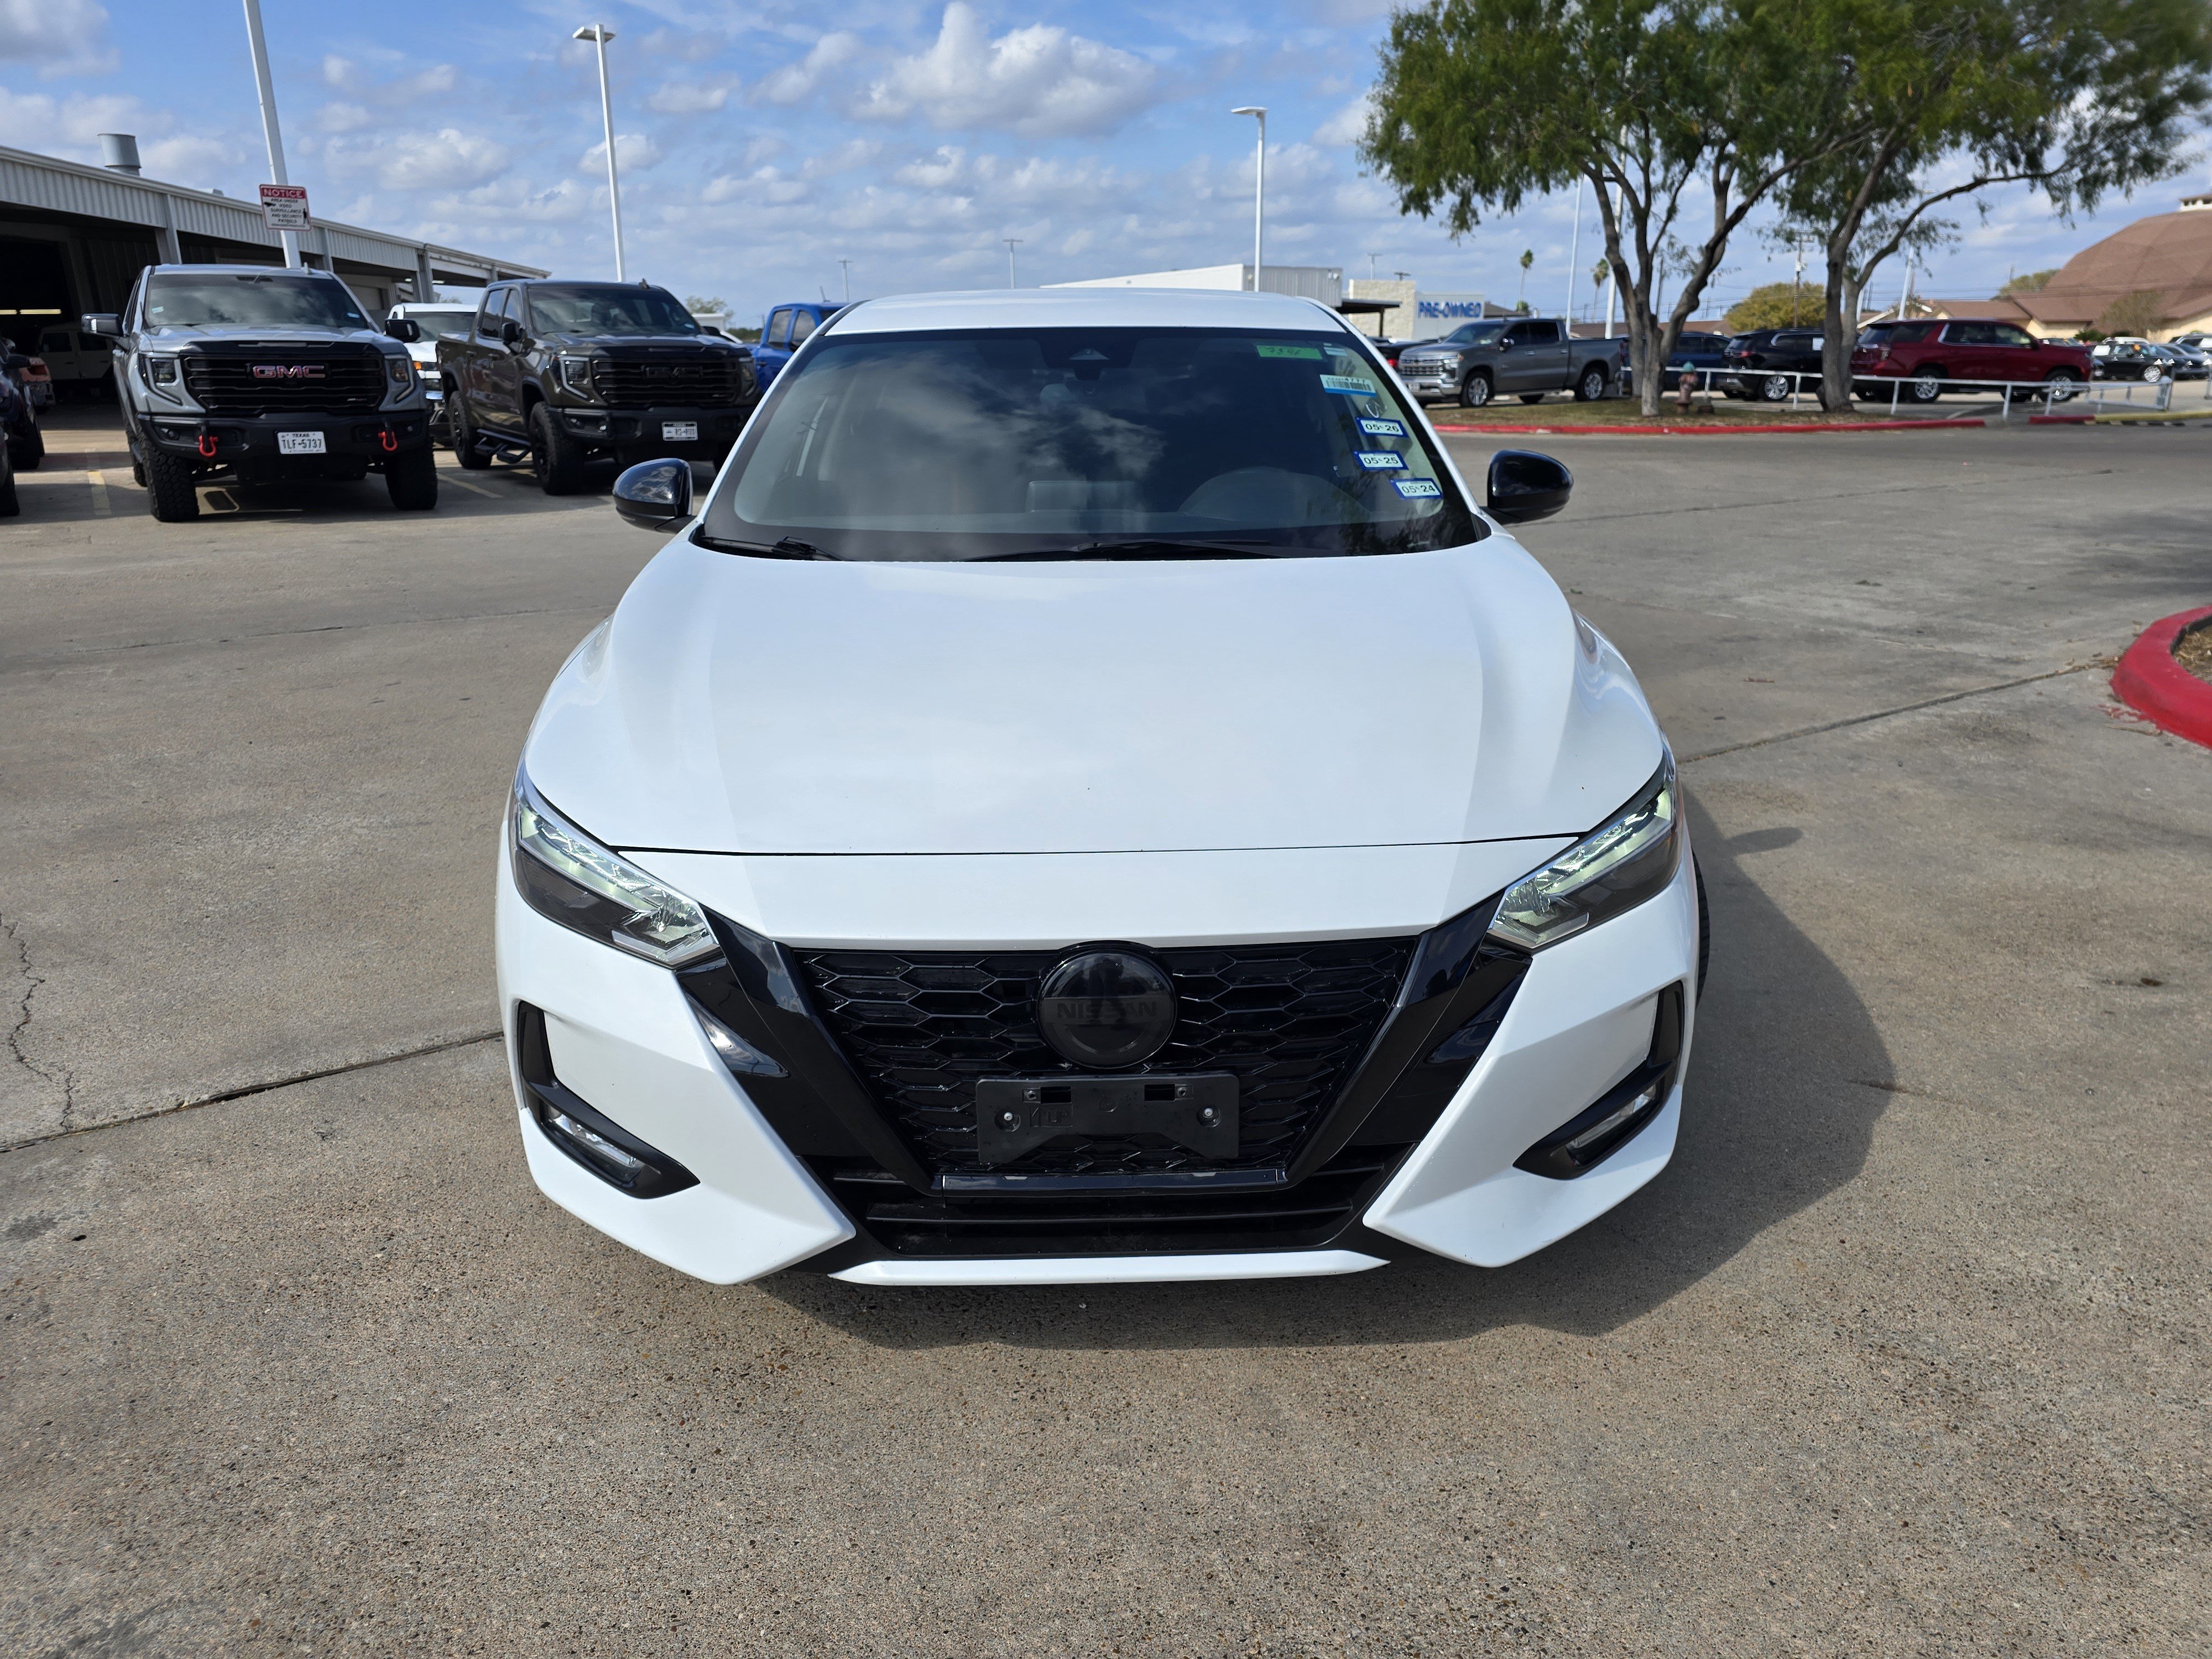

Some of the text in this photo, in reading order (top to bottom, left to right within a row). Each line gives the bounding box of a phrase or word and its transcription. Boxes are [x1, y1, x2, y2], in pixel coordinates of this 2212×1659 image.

[263, 189, 303, 198] NOTICE
[1417, 301, 1481, 319] PRE-OWNED
[253, 365, 326, 378] GMC
[281, 439, 322, 449] TLF-5737
[1057, 1001, 1157, 1019] NISSAN
[1047, 1110, 1070, 1124] UP
